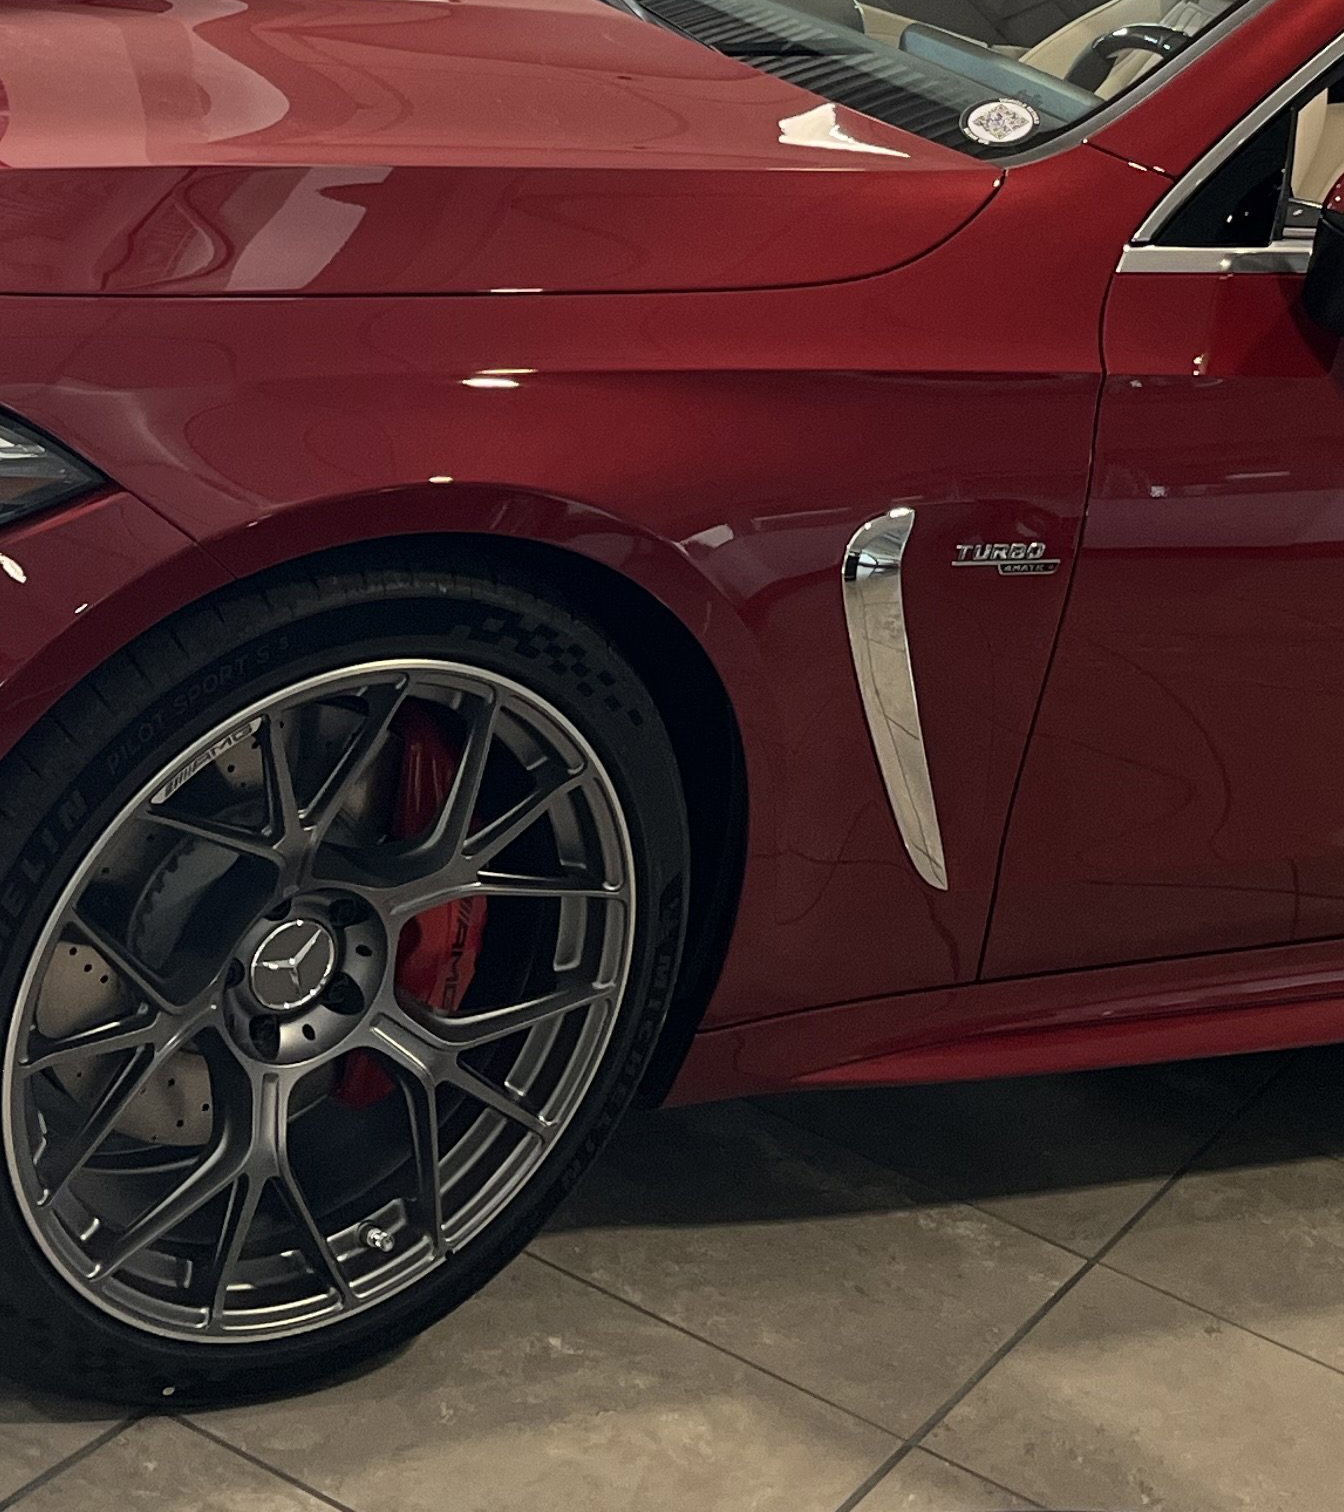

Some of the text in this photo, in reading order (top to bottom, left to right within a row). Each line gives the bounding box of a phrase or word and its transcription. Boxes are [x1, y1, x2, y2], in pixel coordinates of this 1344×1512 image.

[955, 541, 1046, 561] TURBO
[107, 710, 163, 776] PILOT
[171, 654, 250, 716] SPORT
[442, 921, 469, 1009] AMG
